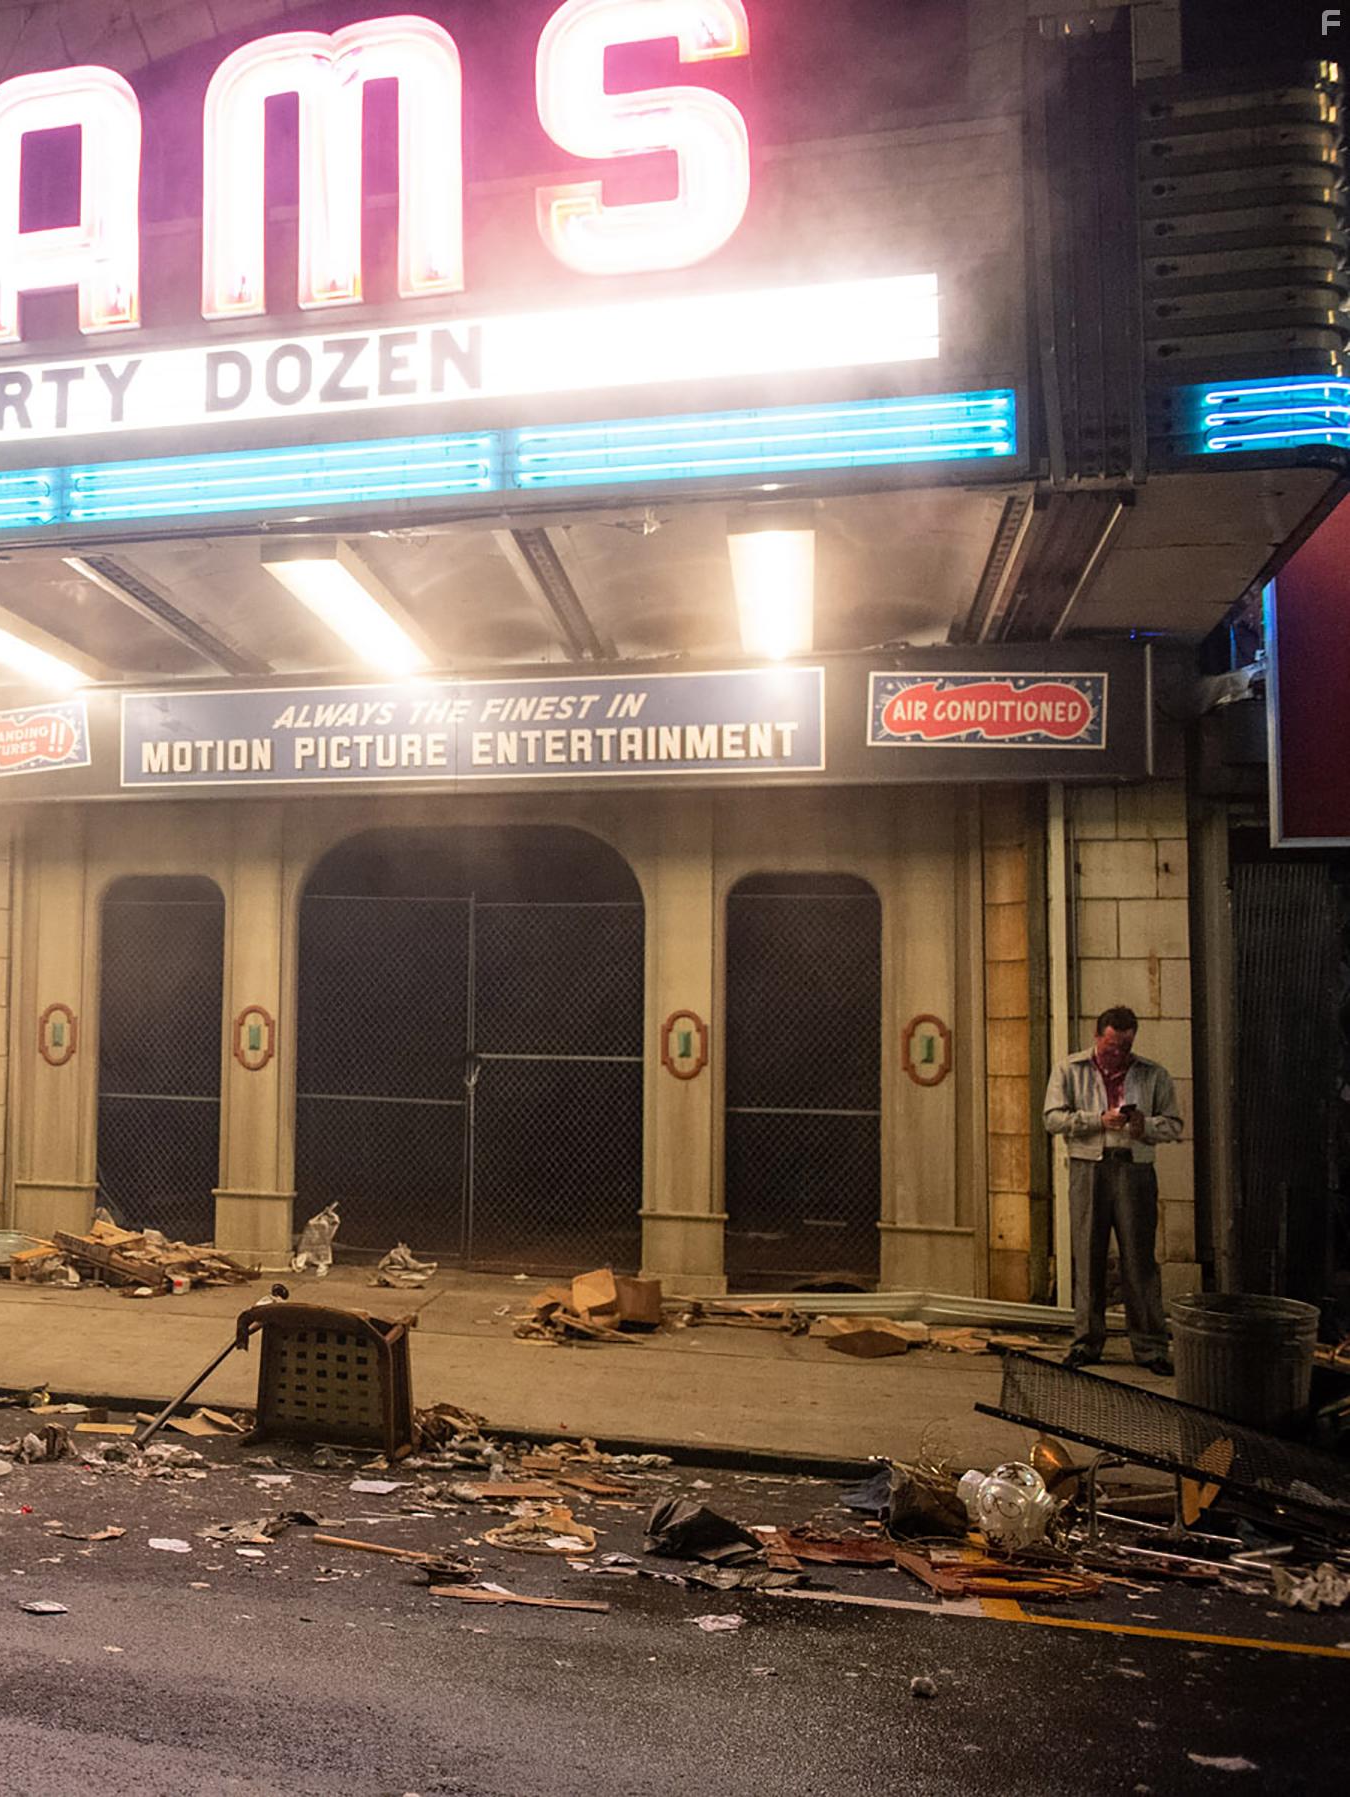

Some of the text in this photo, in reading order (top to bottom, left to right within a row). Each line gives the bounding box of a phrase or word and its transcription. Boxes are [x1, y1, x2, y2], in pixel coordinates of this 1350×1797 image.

[205, 326, 483, 413] DOZEN
[272, 693, 647, 729] ALWAYS THE FINEST IN
[892, 700, 1083, 723] AIR CONDITIONED
[141, 722, 799, 773] MOTION PICTURE ENTERTAINMENT
